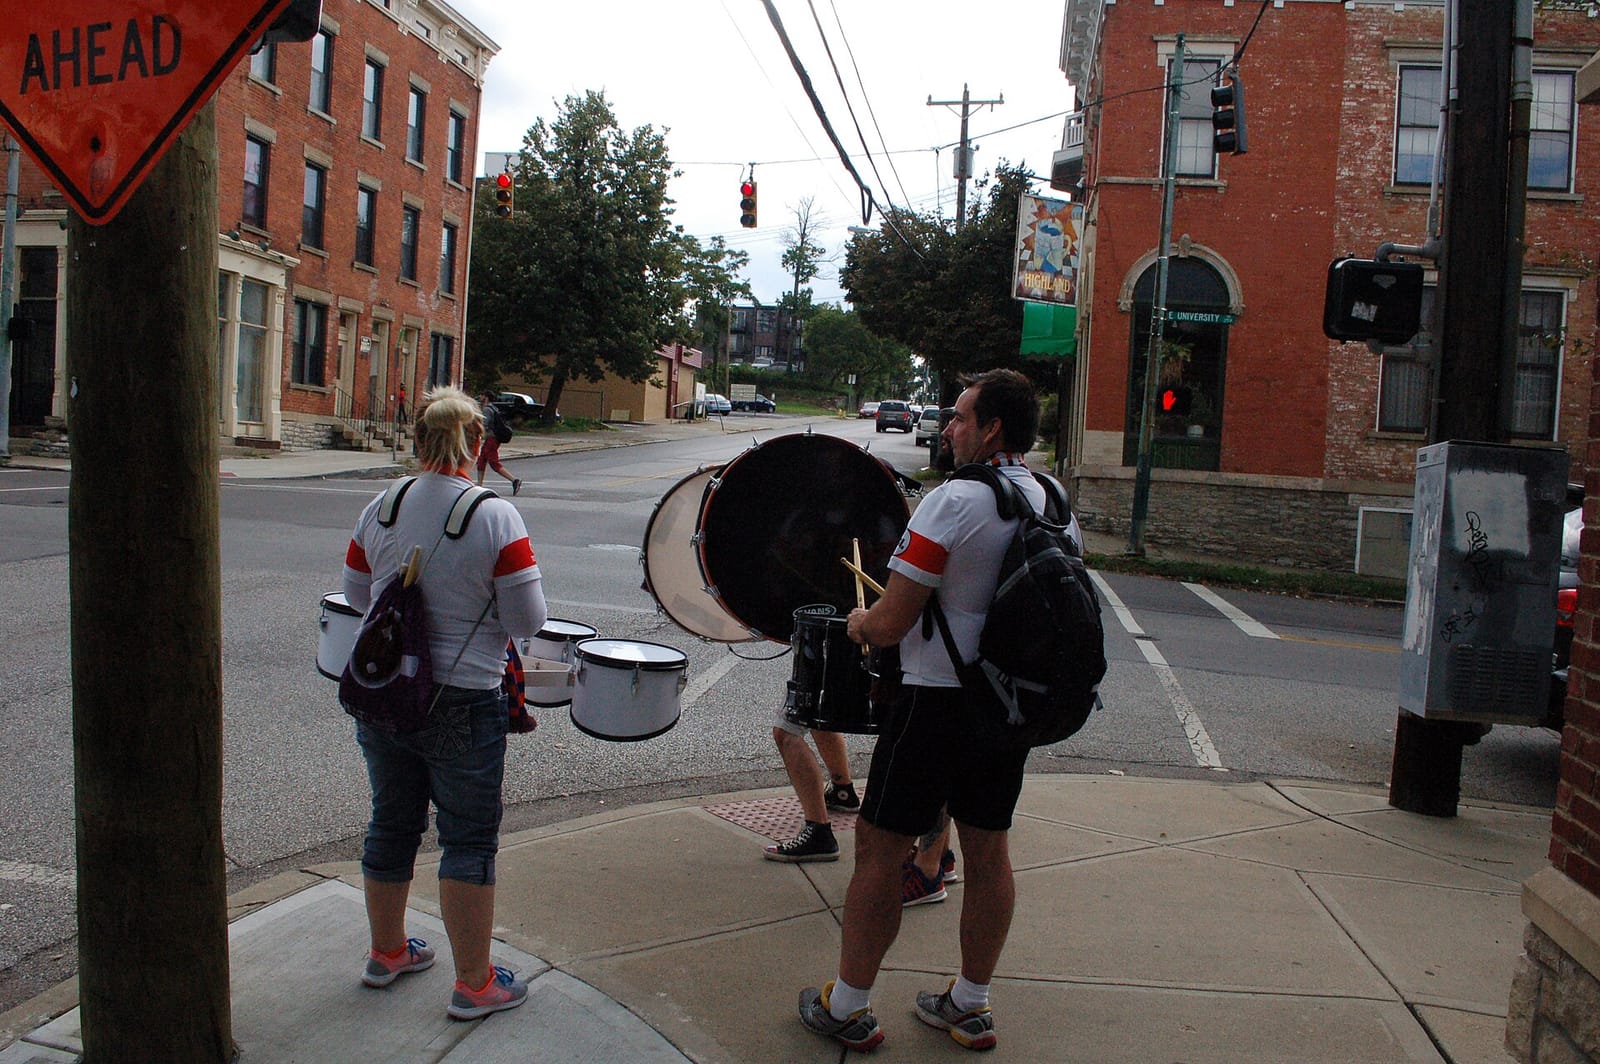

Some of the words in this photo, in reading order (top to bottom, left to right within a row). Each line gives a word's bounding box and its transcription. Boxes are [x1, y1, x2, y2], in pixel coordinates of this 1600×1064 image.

[19, 14, 183, 95] AHEAD
[1024, 272, 1071, 293] HIGHLAND
[1168, 311, 1174, 320] E
[1177, 311, 1220, 322] UNIVERSITY
